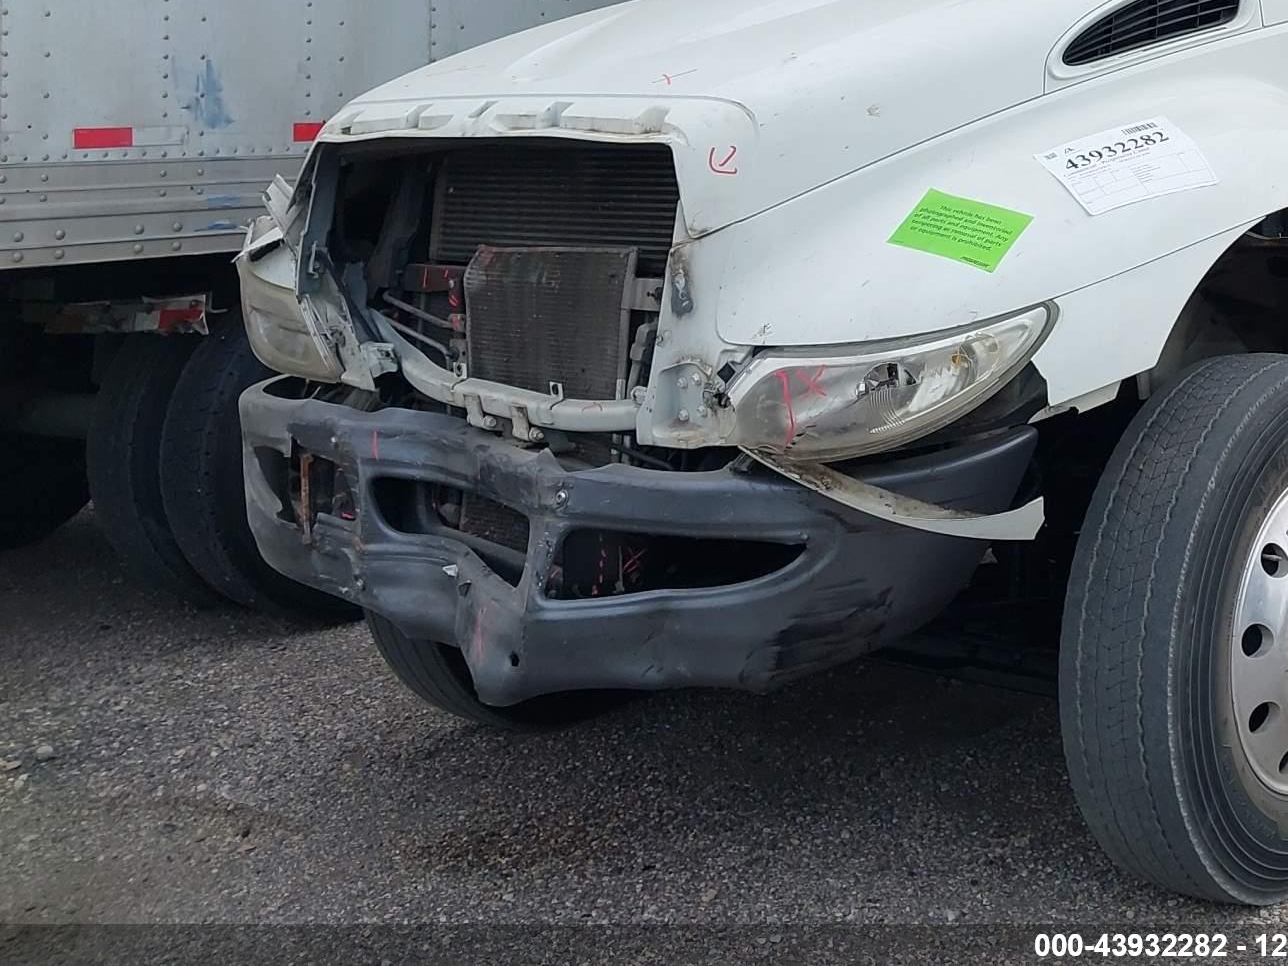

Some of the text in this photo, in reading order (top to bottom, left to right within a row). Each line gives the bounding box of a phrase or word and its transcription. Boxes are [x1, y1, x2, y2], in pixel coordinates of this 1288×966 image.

[1065, 131, 1169, 170] 43932282
[952, 209, 973, 217] vehicle
[985, 217, 1002, 225] been
[929, 217, 946, 225] parts
[995, 233, 1009, 243] Any
[983, 238, 1001, 247] parts
